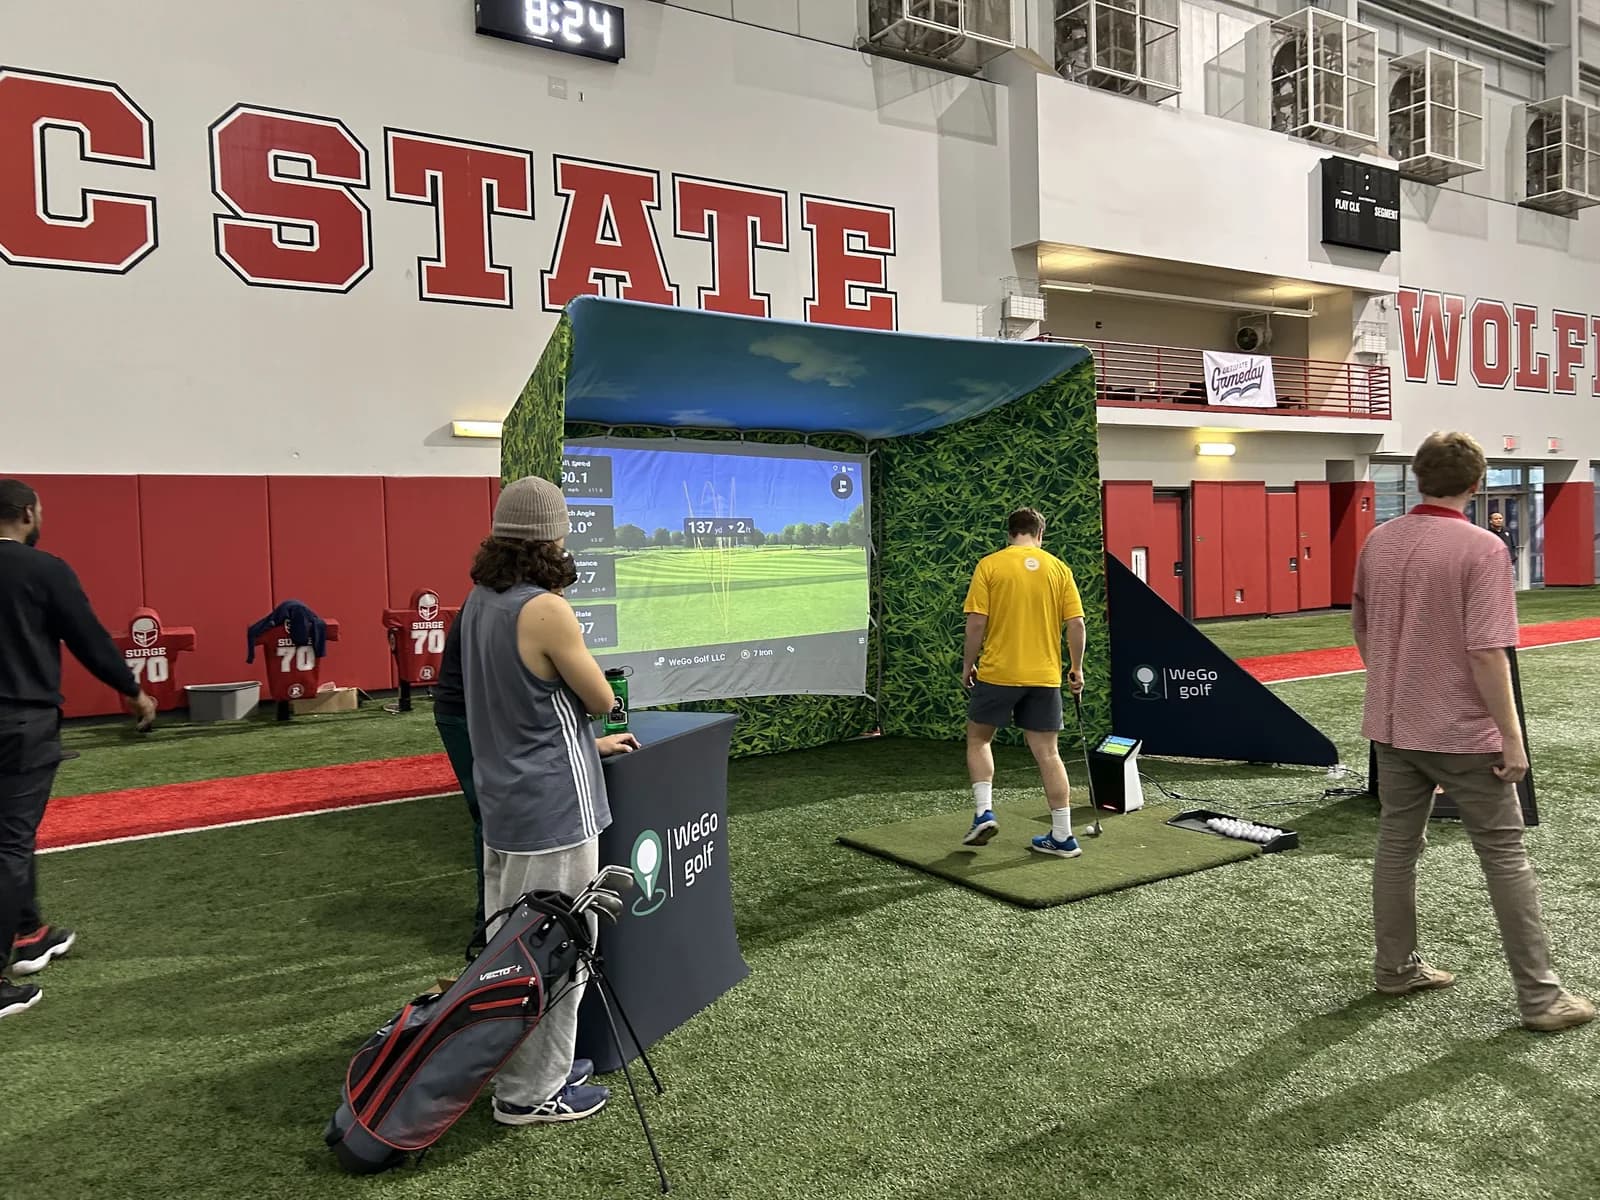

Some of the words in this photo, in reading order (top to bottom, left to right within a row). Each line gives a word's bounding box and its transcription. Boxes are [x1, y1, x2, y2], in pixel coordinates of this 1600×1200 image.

[524, 0, 613, 48] 8:24
[1335, 198, 1349, 211] PLAY
[1349, 201, 1361, 213] CLK
[1374, 206, 1399, 220] SEGMENT
[207, 103, 898, 331] STATE
[1211, 358, 1265, 396] Gameday
[688, 521, 713, 534] 137
[736, 521, 745, 534] 2
[412, 621, 444, 630] SURGE
[411, 629, 446, 655] 70
[125, 647, 167, 658] SURGE
[276, 646, 316, 673] 70
[669, 657, 692, 667] WeGo
[694, 654, 709, 664] Golf
[711, 653, 726, 662] LLC
[759, 649, 773, 657] Iron
[125, 656, 169, 684] 70
[1169, 668, 1218, 681] WeGo
[1179, 683, 1213, 700] golf
[673, 812, 718, 850] WeGo
[684, 840, 714, 887] golf
